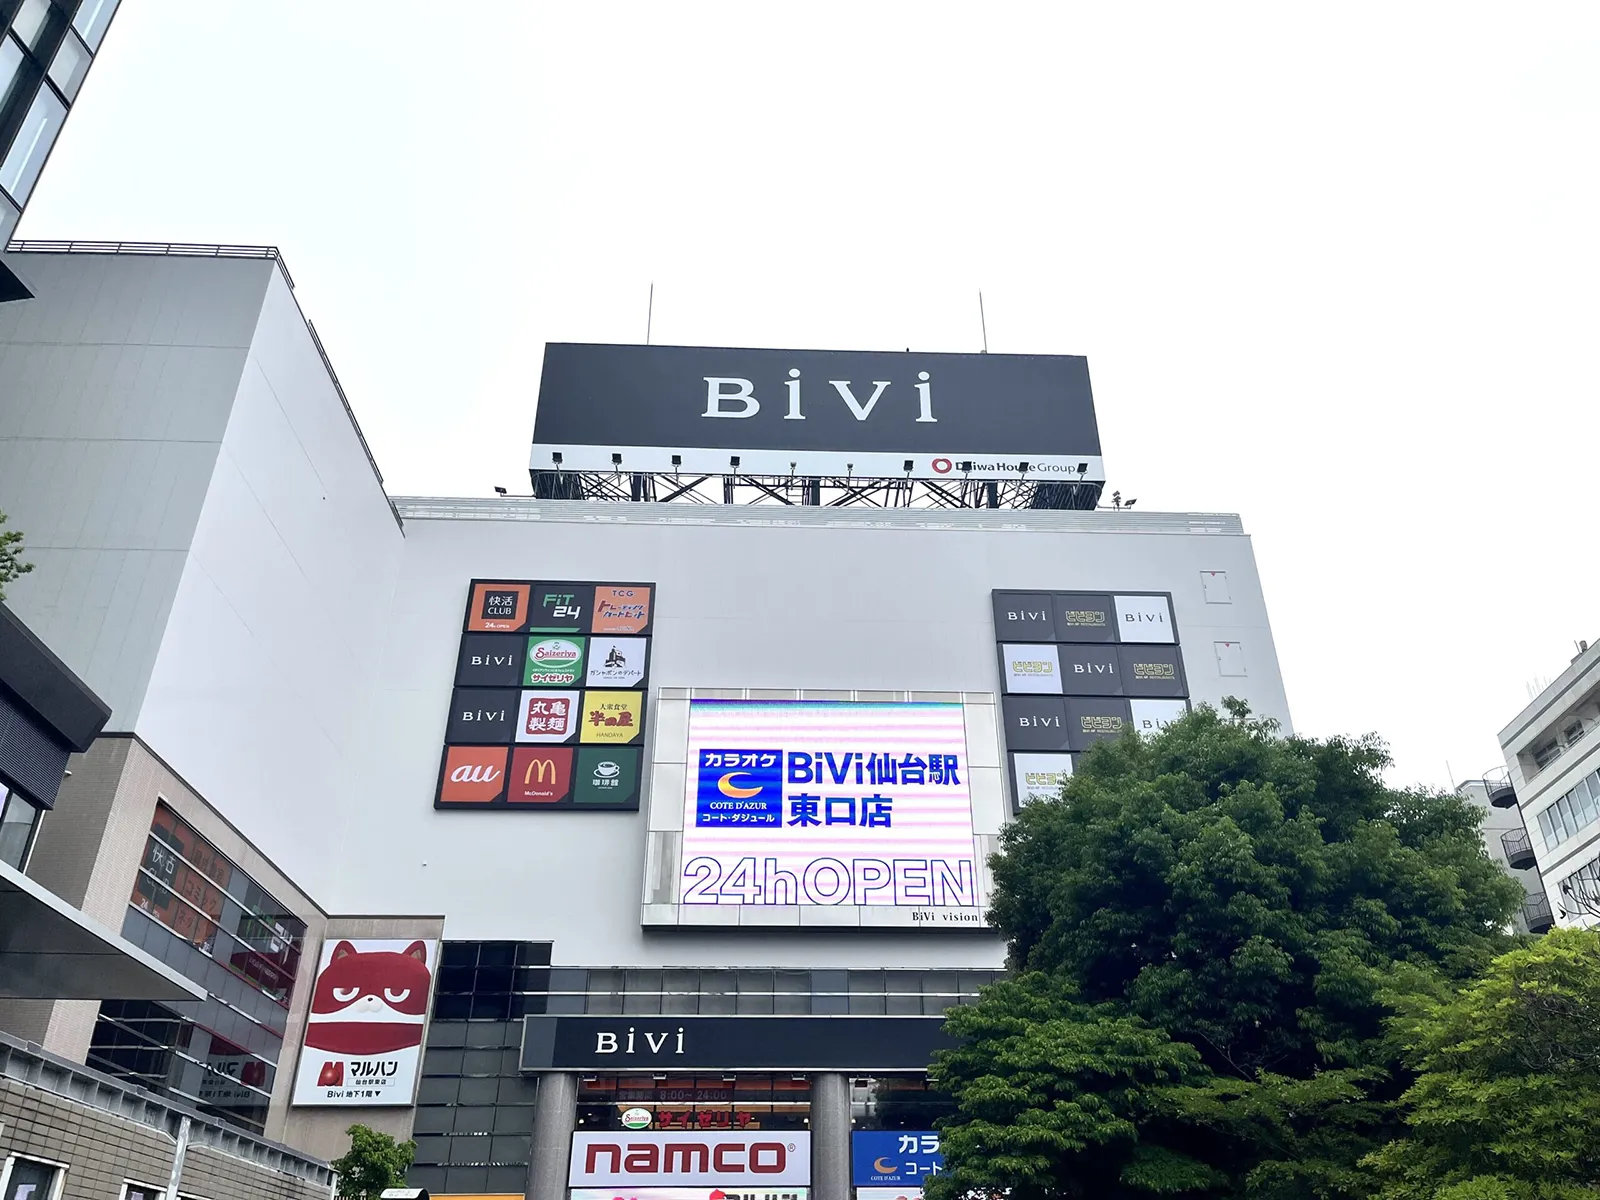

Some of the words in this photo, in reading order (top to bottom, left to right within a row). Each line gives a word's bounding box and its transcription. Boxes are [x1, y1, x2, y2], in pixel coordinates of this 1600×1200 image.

[702, 368, 938, 422] BiVi
[955, 462, 995, 472] Diwa
[996, 462, 1036, 472] Houe
[1037, 463, 1076, 474] Group
[488, 595, 513, 606] 快活
[487, 607, 512, 615] CLUB
[553, 605, 581, 620] 24
[1007, 611, 1047, 621] BiVi
[1125, 612, 1163, 622] BiVi
[535, 647, 577, 660] Saizeriya
[471, 656, 513, 666] BiVi
[1073, 662, 1114, 674] BiVi
[531, 673, 574, 683] サイゼリヤ
[530, 700, 567, 716] 丸亀
[462, 710, 505, 722] BiVi
[1019, 715, 1060, 728] BiVi
[705, 753, 777, 768] カラオケ
[450, 764, 501, 783] au
[787, 751, 961, 786] BiVi仙台駅
[592, 779, 619, 787] 珈琲館
[709, 801, 734, 810] COTE
[787, 793, 893, 828] 東口店
[912, 911, 935, 921] BiVi
[942, 912, 978, 921] vision
[595, 1027, 685, 1054] BiVi
[350, 1061, 398, 1077] マルハン
[327, 1090, 344, 1098] Bivi
[346, 1090, 373, 1098] 地下1階
[697, 1090, 727, 1100] 24:00
[657, 1109, 752, 1128] サイゼリヤ
[898, 1134, 940, 1154] カラ
[905, 1161, 943, 1176] コート
